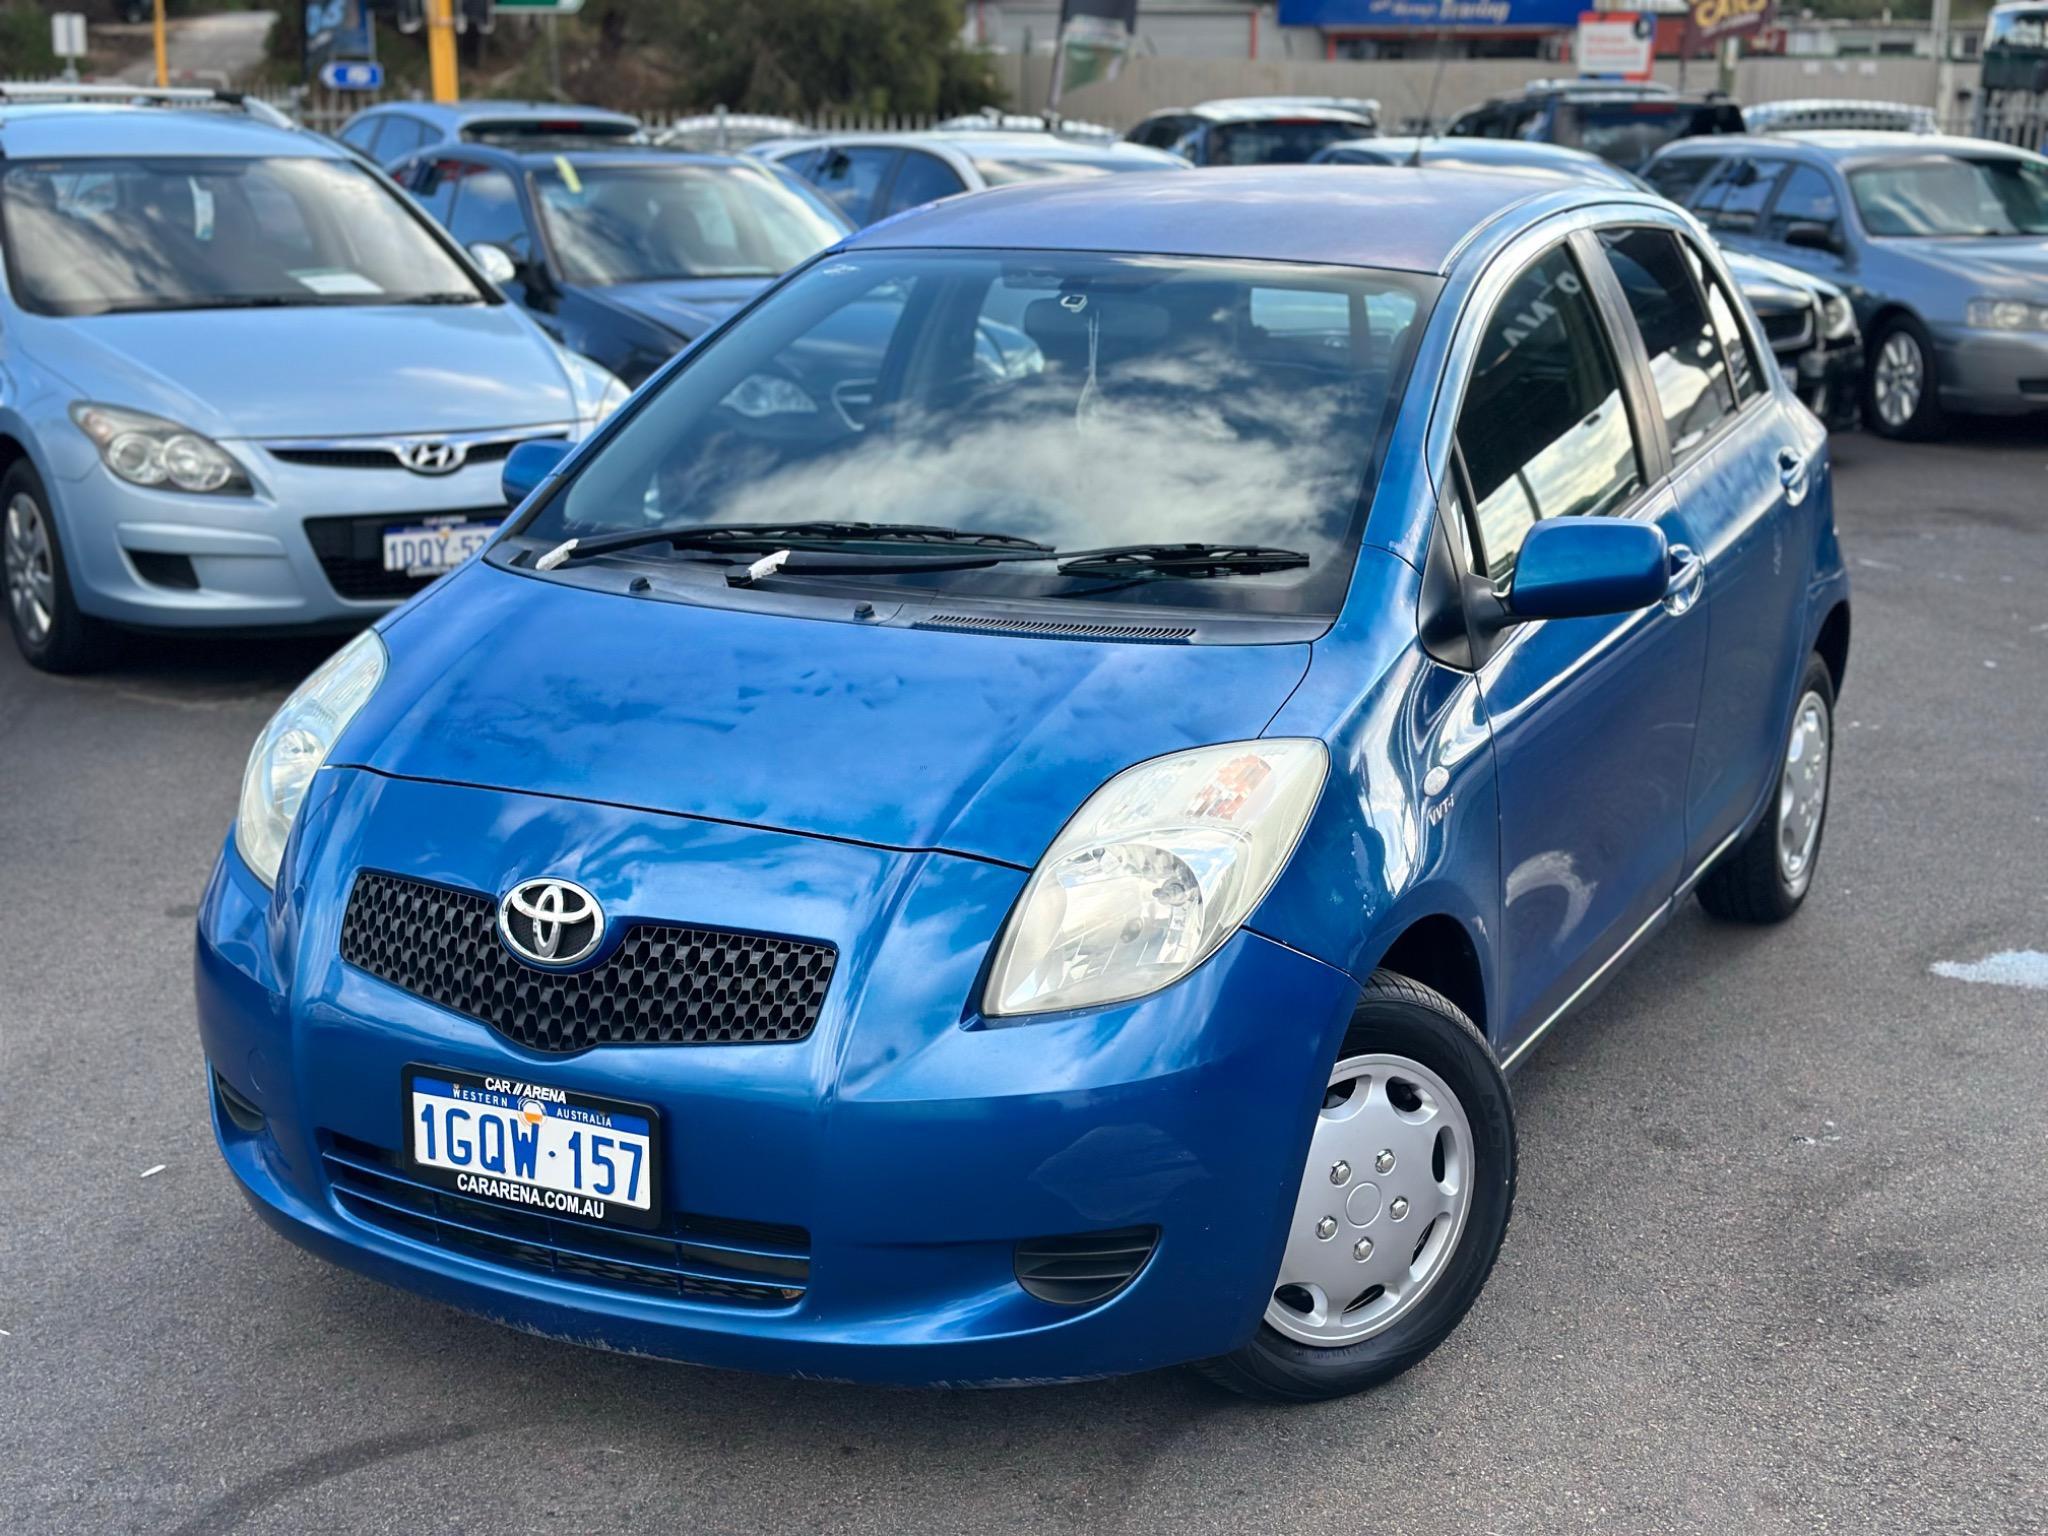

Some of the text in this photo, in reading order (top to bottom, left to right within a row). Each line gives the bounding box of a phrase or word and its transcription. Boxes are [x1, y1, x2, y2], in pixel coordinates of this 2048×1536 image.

[452, 1088, 612, 1128] WESTERN AUSTRALIA
[457, 1173, 605, 1218] CARARENA.COM.AU
